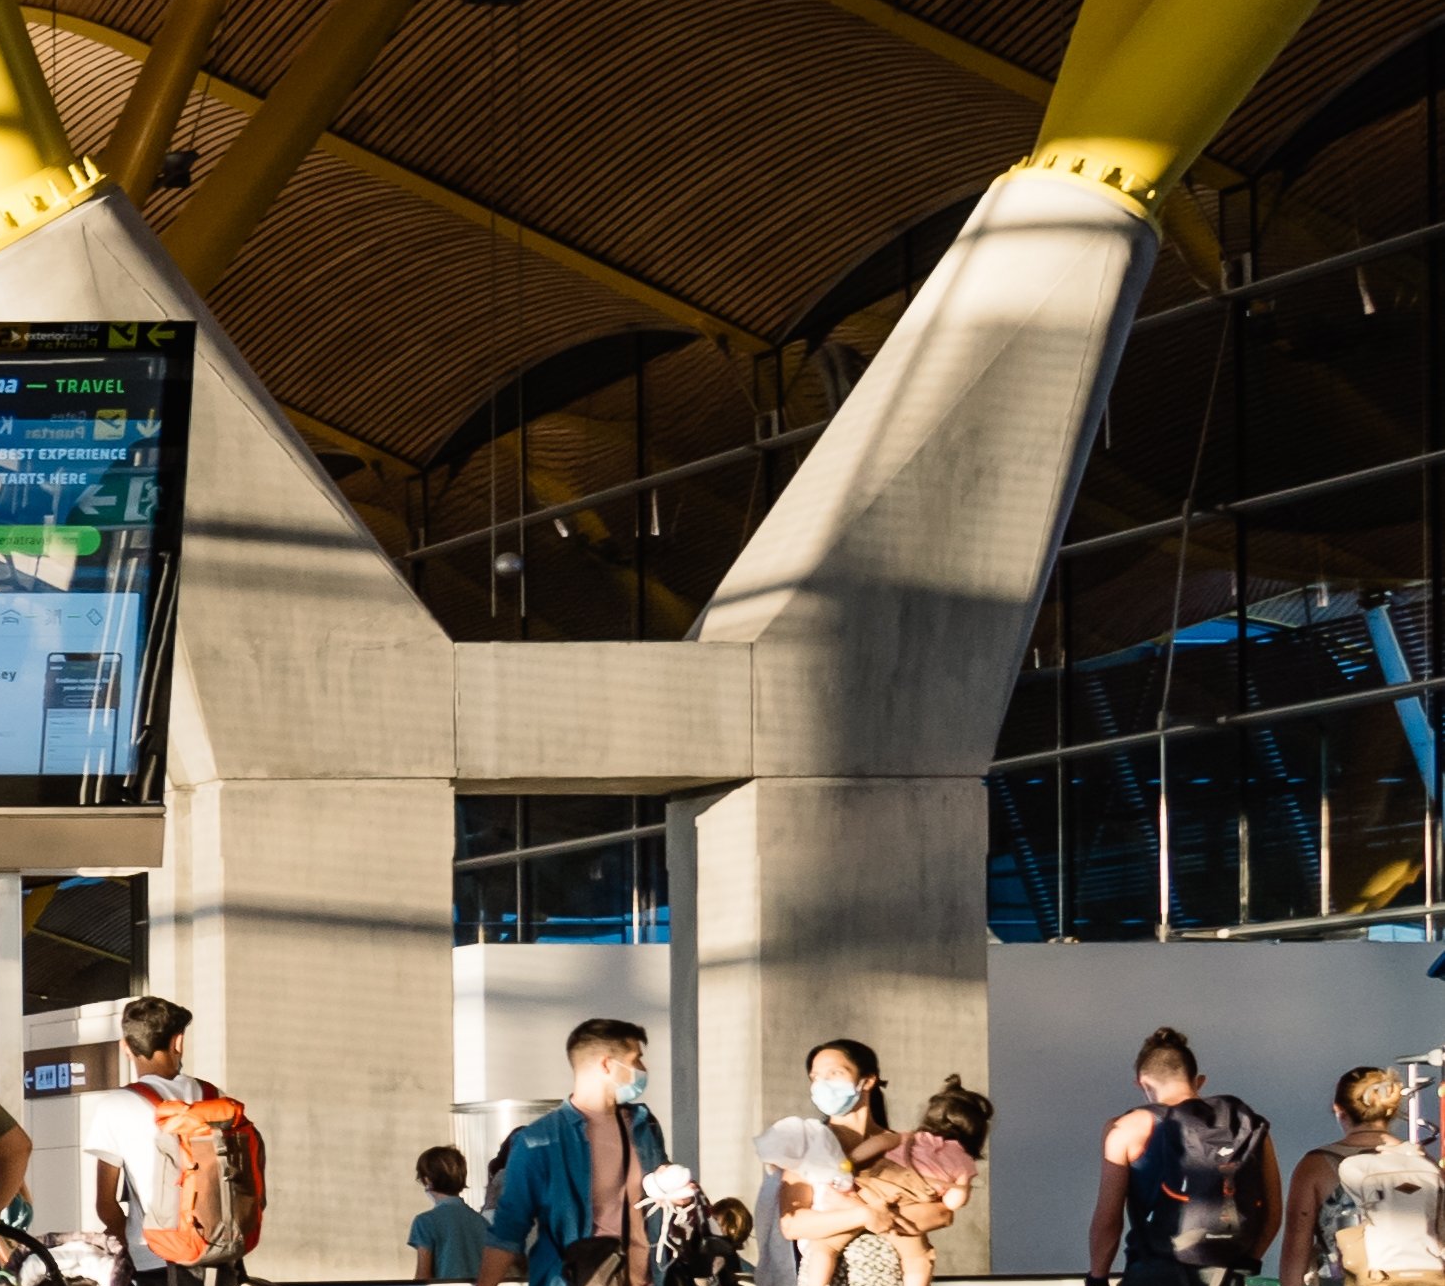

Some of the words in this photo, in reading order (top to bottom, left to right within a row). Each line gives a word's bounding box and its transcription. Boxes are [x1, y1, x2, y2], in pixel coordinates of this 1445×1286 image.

[56, 379, 125, 394] TRAVEL
[0, 448, 34, 460] BEST
[38, 448, 127, 461] EXPERIENCE
[49, 472, 87, 485] HERE
